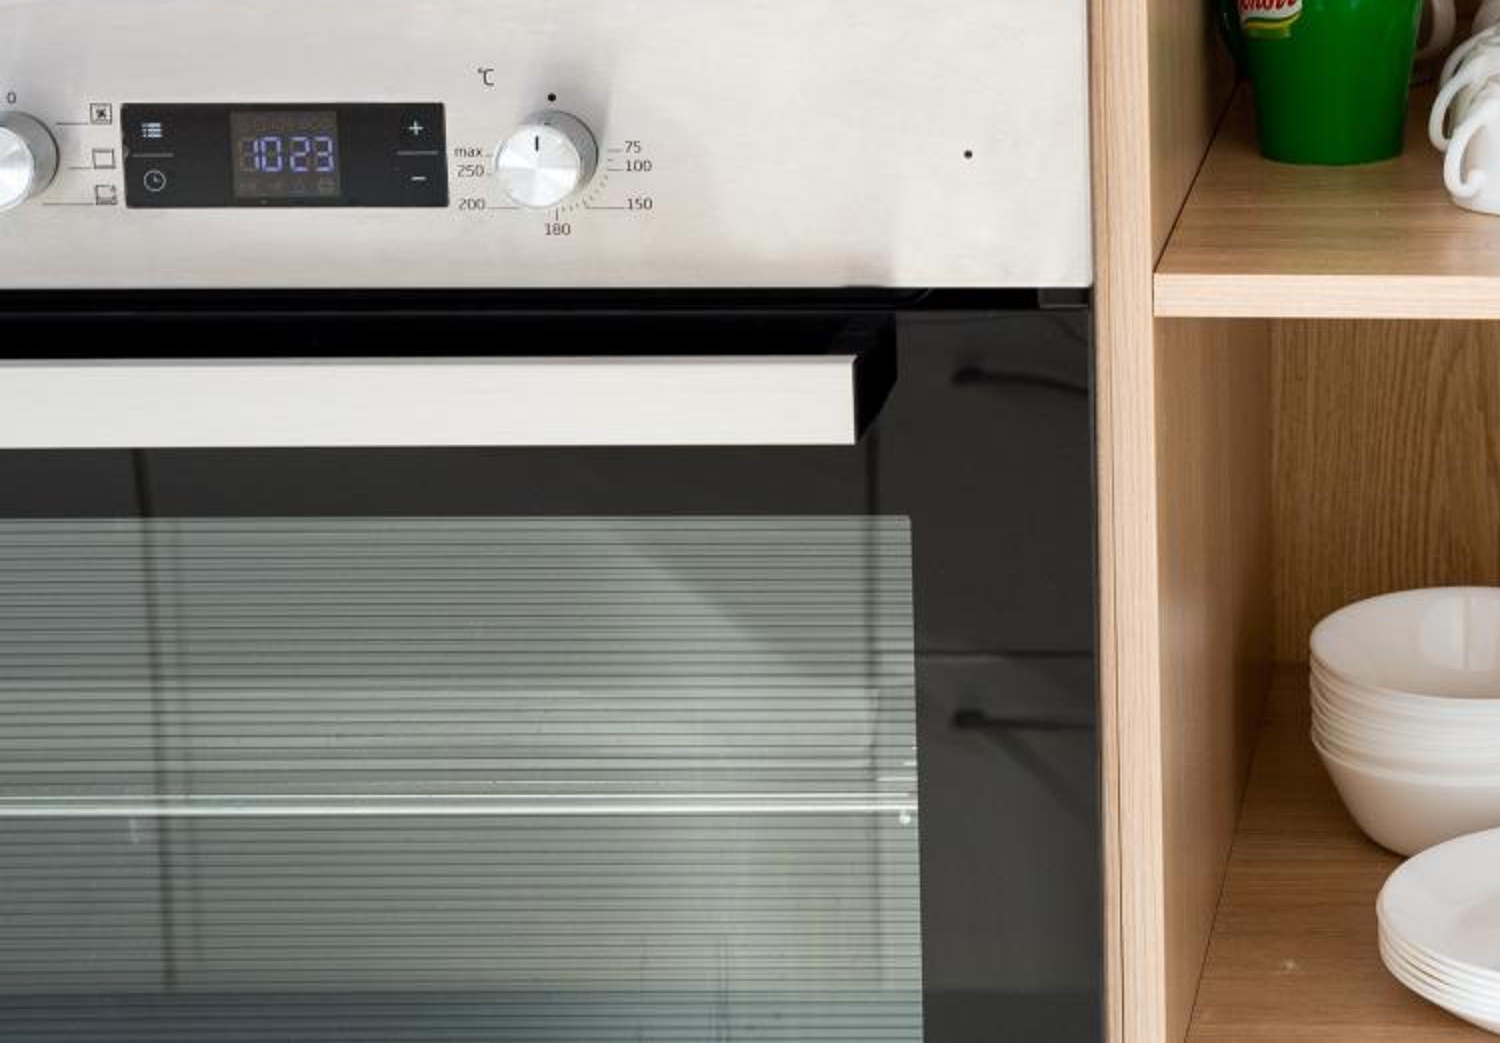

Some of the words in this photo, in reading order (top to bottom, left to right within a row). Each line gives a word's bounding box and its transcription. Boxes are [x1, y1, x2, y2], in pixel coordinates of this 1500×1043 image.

[454, 147, 482, 158] max
[625, 140, 641, 154] 75
[253, 136, 335, 172] 1023
[457, 165, 485, 178] 250
[625, 160, 653, 172] 100
[458, 198, 486, 211] 200
[627, 198, 653, 211] 150
[544, 223, 571, 236] 180
